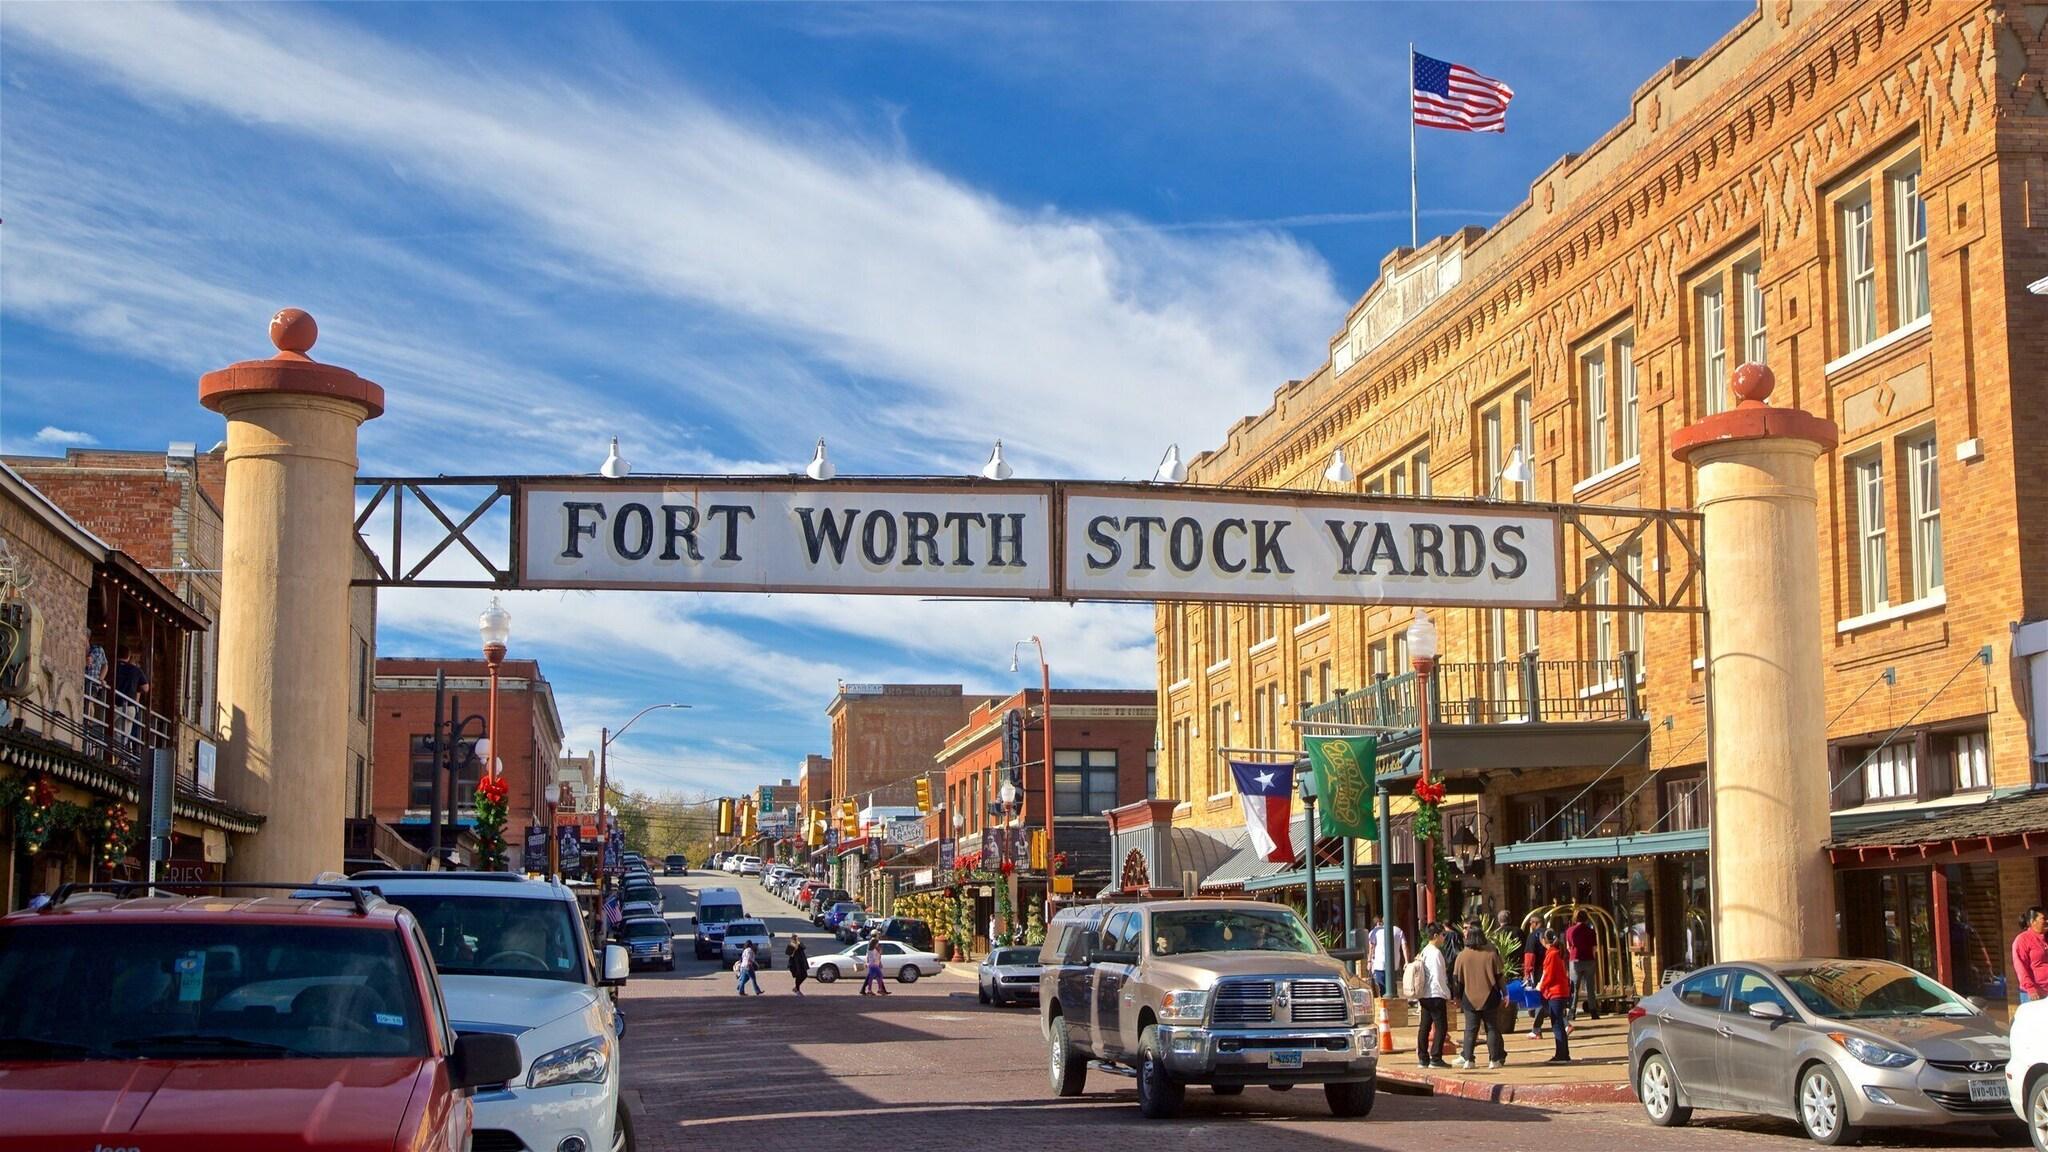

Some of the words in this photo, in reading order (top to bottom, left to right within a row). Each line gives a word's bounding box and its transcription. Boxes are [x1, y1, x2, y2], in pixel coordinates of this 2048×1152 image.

[560, 501, 756, 563] FORT
[793, 505, 1028, 569] WORTH
[1085, 514, 1296, 575] STOCK
[1324, 519, 1528, 581] YARDS
